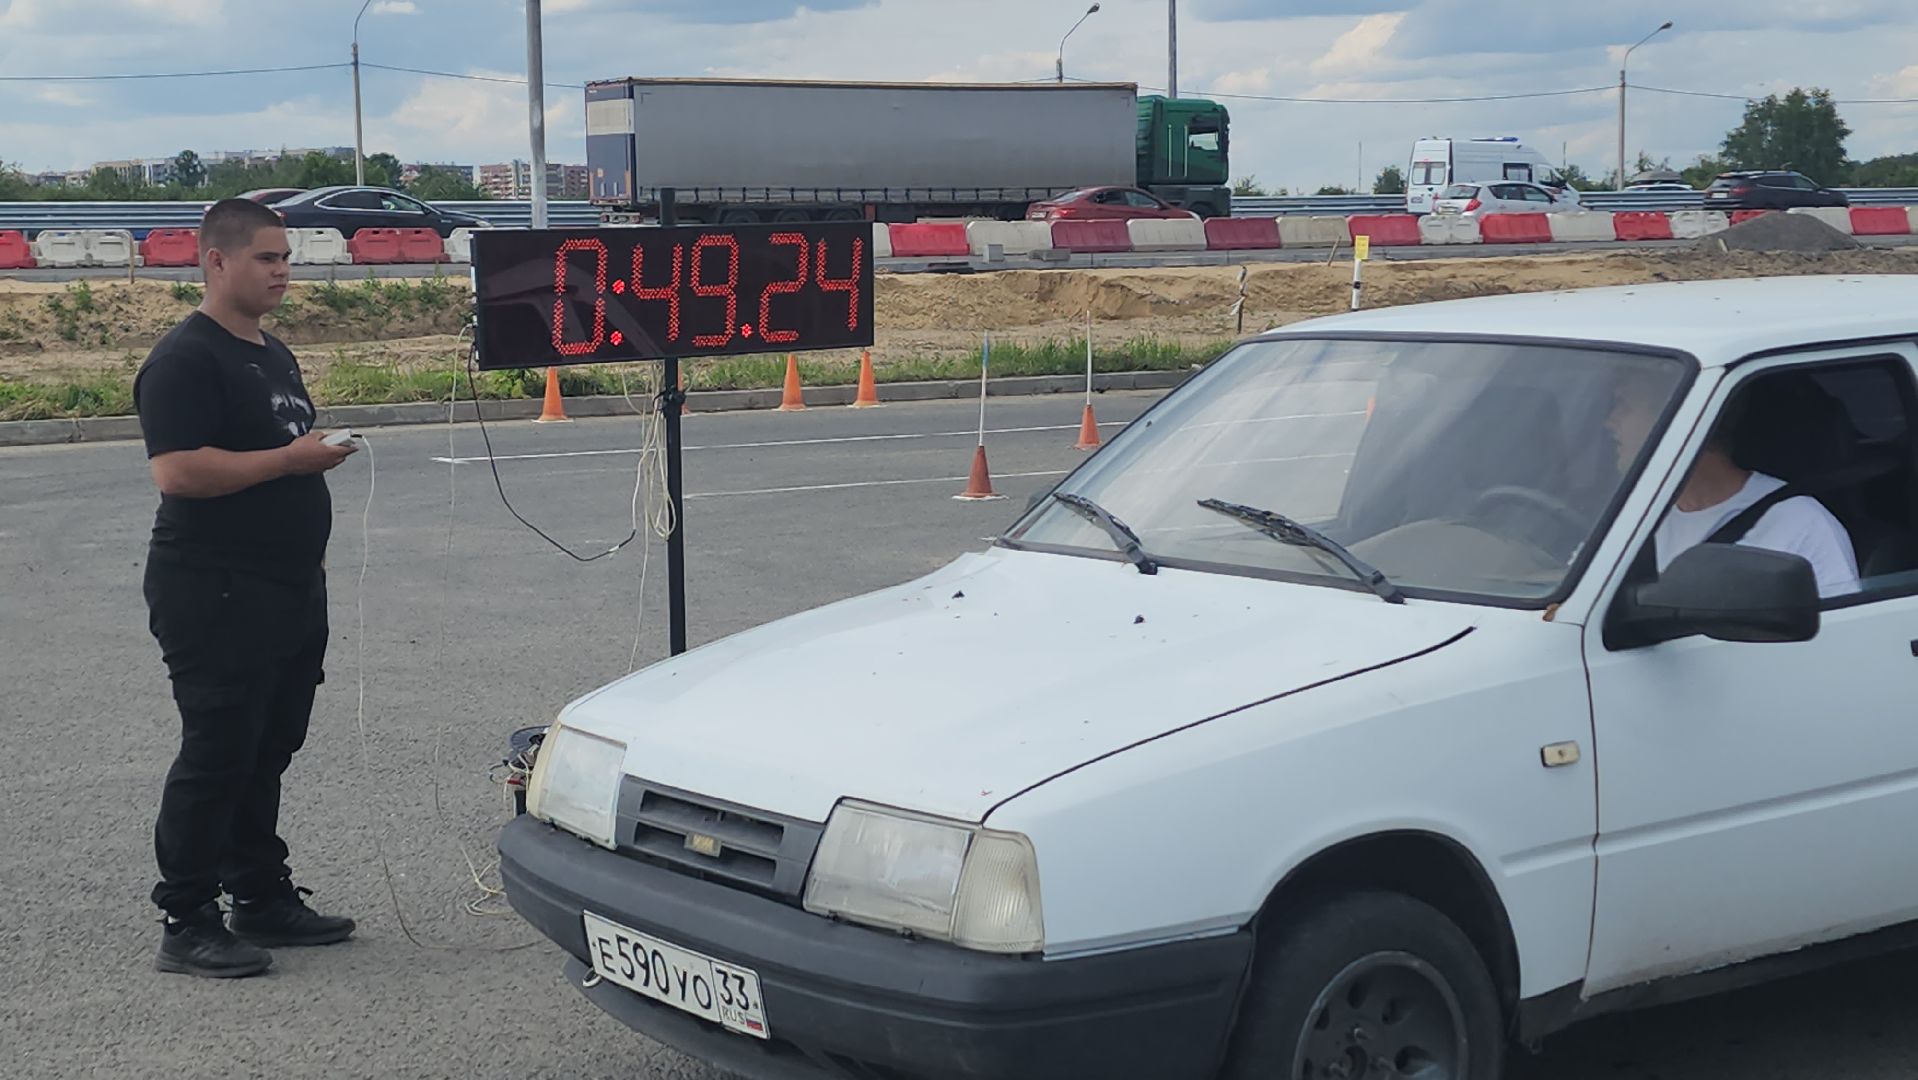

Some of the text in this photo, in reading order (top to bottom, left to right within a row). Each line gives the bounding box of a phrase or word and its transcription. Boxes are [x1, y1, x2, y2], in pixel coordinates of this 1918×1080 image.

[552, 233, 863, 355] 0:49.24
[715, 968, 749, 1010] 33
[722, 1006, 745, 1024] RUS
